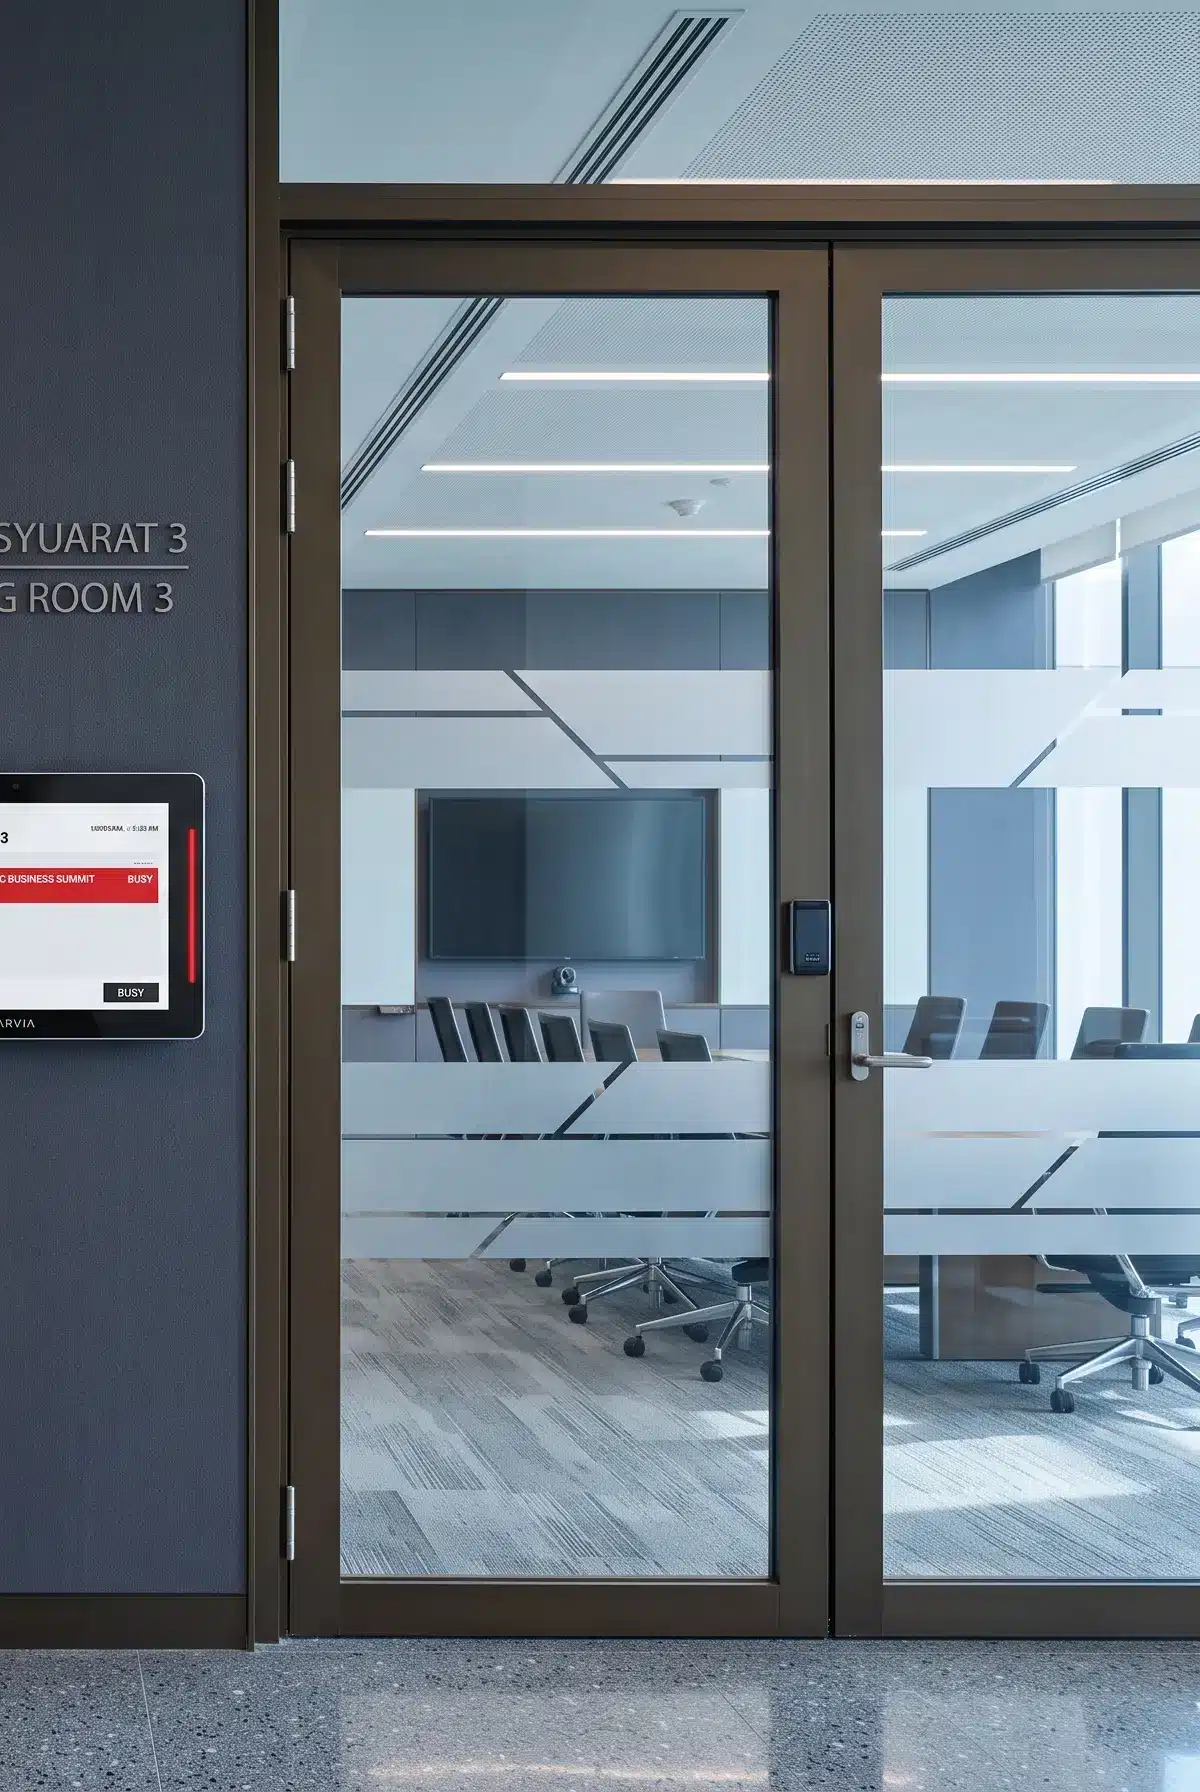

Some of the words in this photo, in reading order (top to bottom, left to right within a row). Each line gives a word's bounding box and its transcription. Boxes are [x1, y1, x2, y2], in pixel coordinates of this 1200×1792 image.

[169, 522, 187, 553] 3
[29, 582, 143, 613] ROOM
[154, 582, 174, 613] 3
[0, 831, 9, 844] 3
[8, 874, 55, 884] BUSINESS
[56, 874, 95, 884] SUMMIT
[127, 874, 154, 884] BUSY
[117, 988, 145, 998] BUSY
